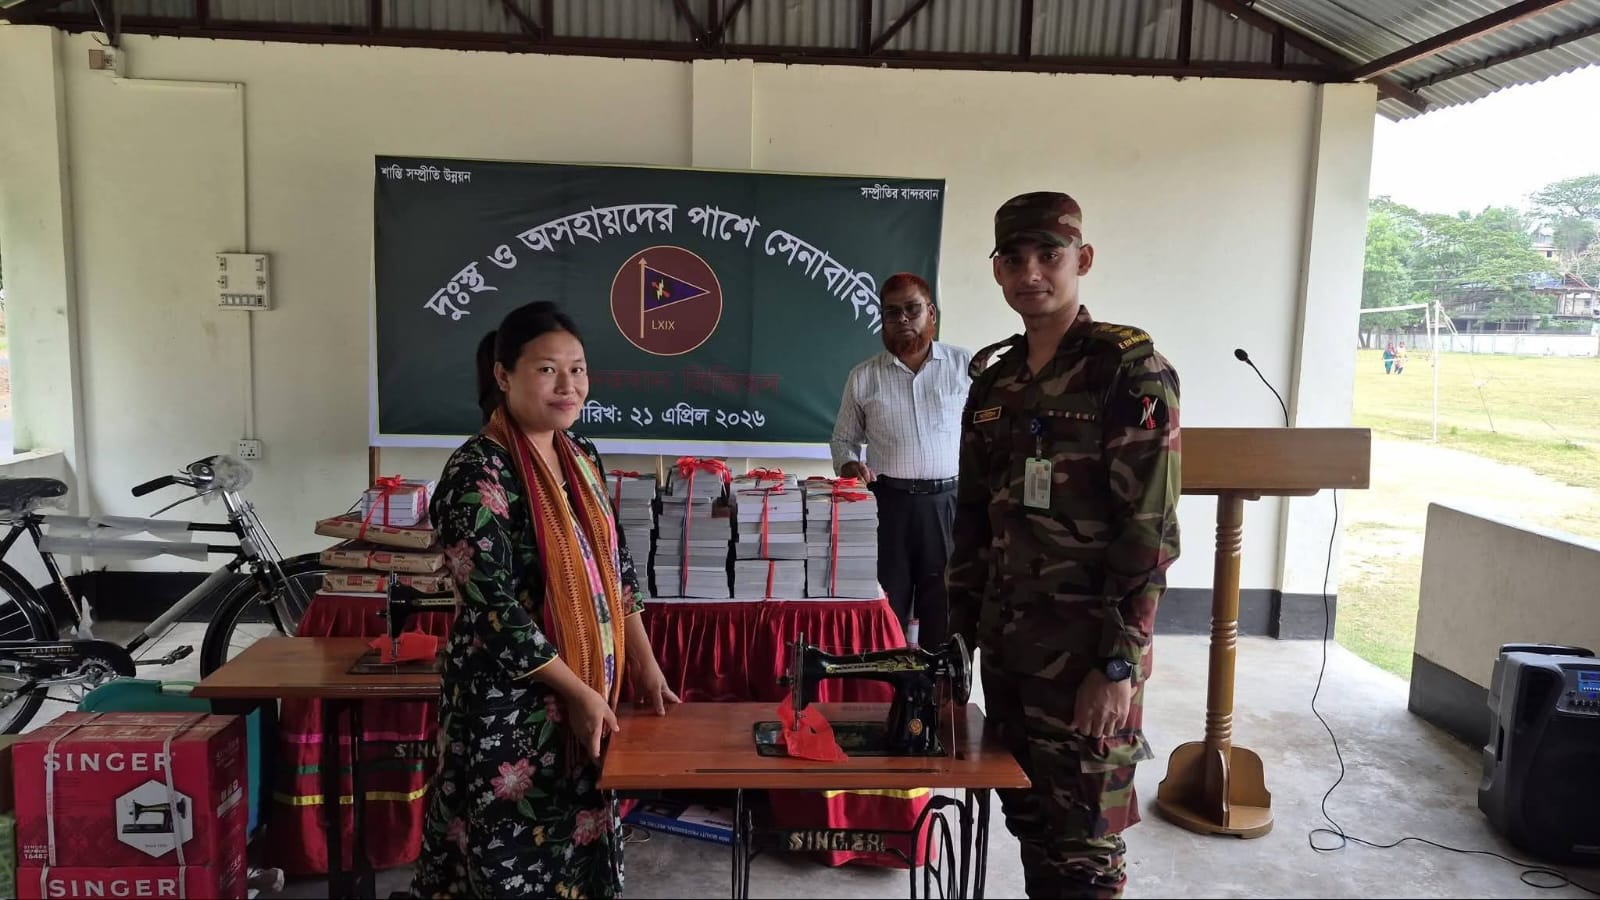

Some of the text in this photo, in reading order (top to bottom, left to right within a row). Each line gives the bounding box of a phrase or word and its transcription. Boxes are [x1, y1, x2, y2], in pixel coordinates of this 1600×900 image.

[380, 163, 472, 184] শান্তি সম্প্রীতি উন্নয়ন
[860, 183, 940, 201] সম্প্রীতির বান্দরবান
[423, 260, 499, 321] দুঃস্থ
[487, 244, 518, 270] ও
[515, 203, 678, 252] অসহায়দের
[687, 204, 761, 248] পাশে
[651, 319, 676, 330] LXIX
[580, 399, 766, 429] ারিখ: ২১ এপ্রিল ২০২৬
[788, 830, 881, 852] SINGER
[49, 878, 177, 898] SINGER
